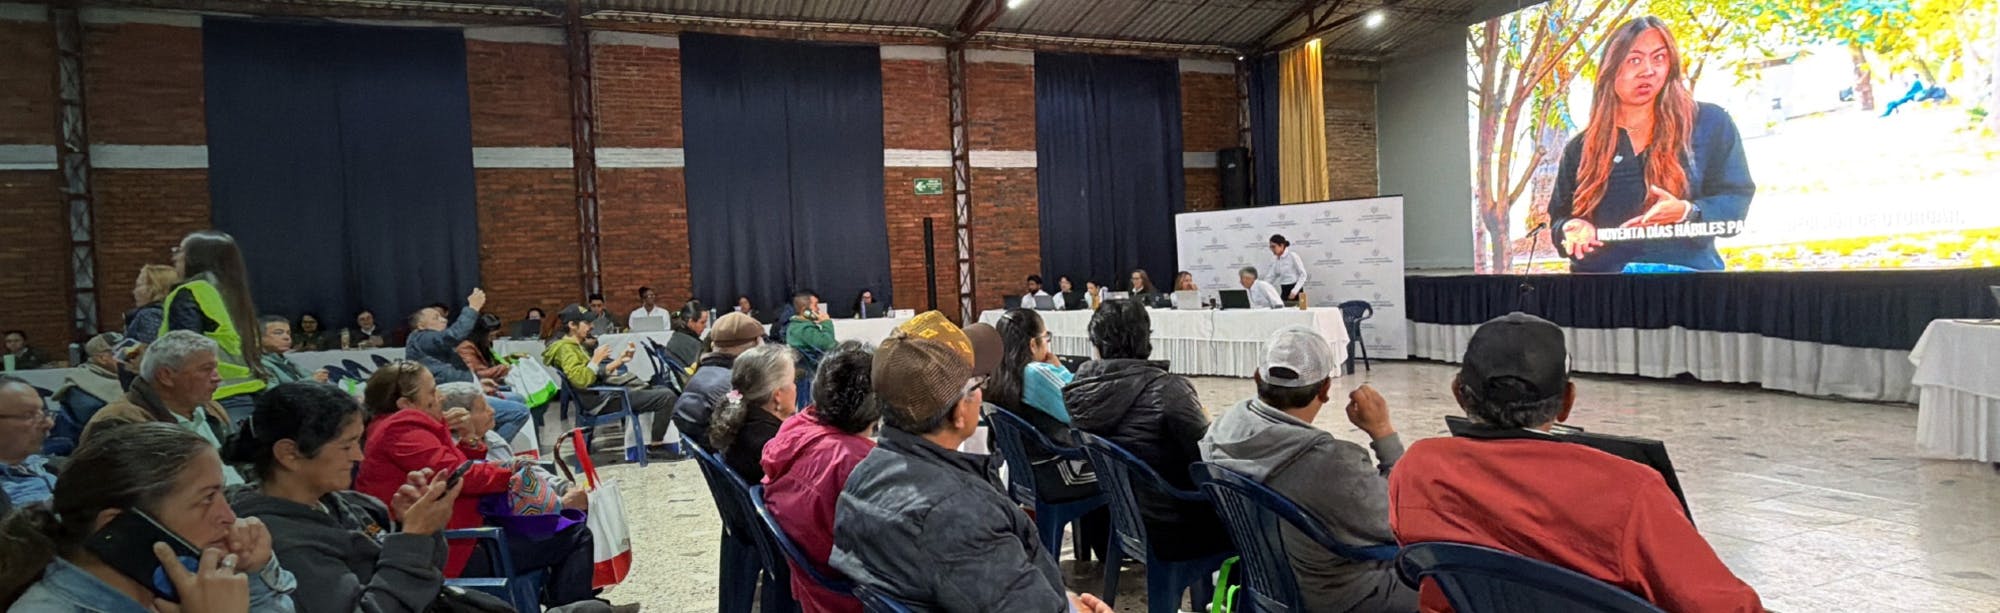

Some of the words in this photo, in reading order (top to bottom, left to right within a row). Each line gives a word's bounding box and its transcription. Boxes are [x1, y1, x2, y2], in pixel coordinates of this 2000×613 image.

[1597, 226, 1645, 241] NOVENTA
[1646, 223, 1674, 238] DÍAS
[1674, 220, 1726, 238] HÁBILES
